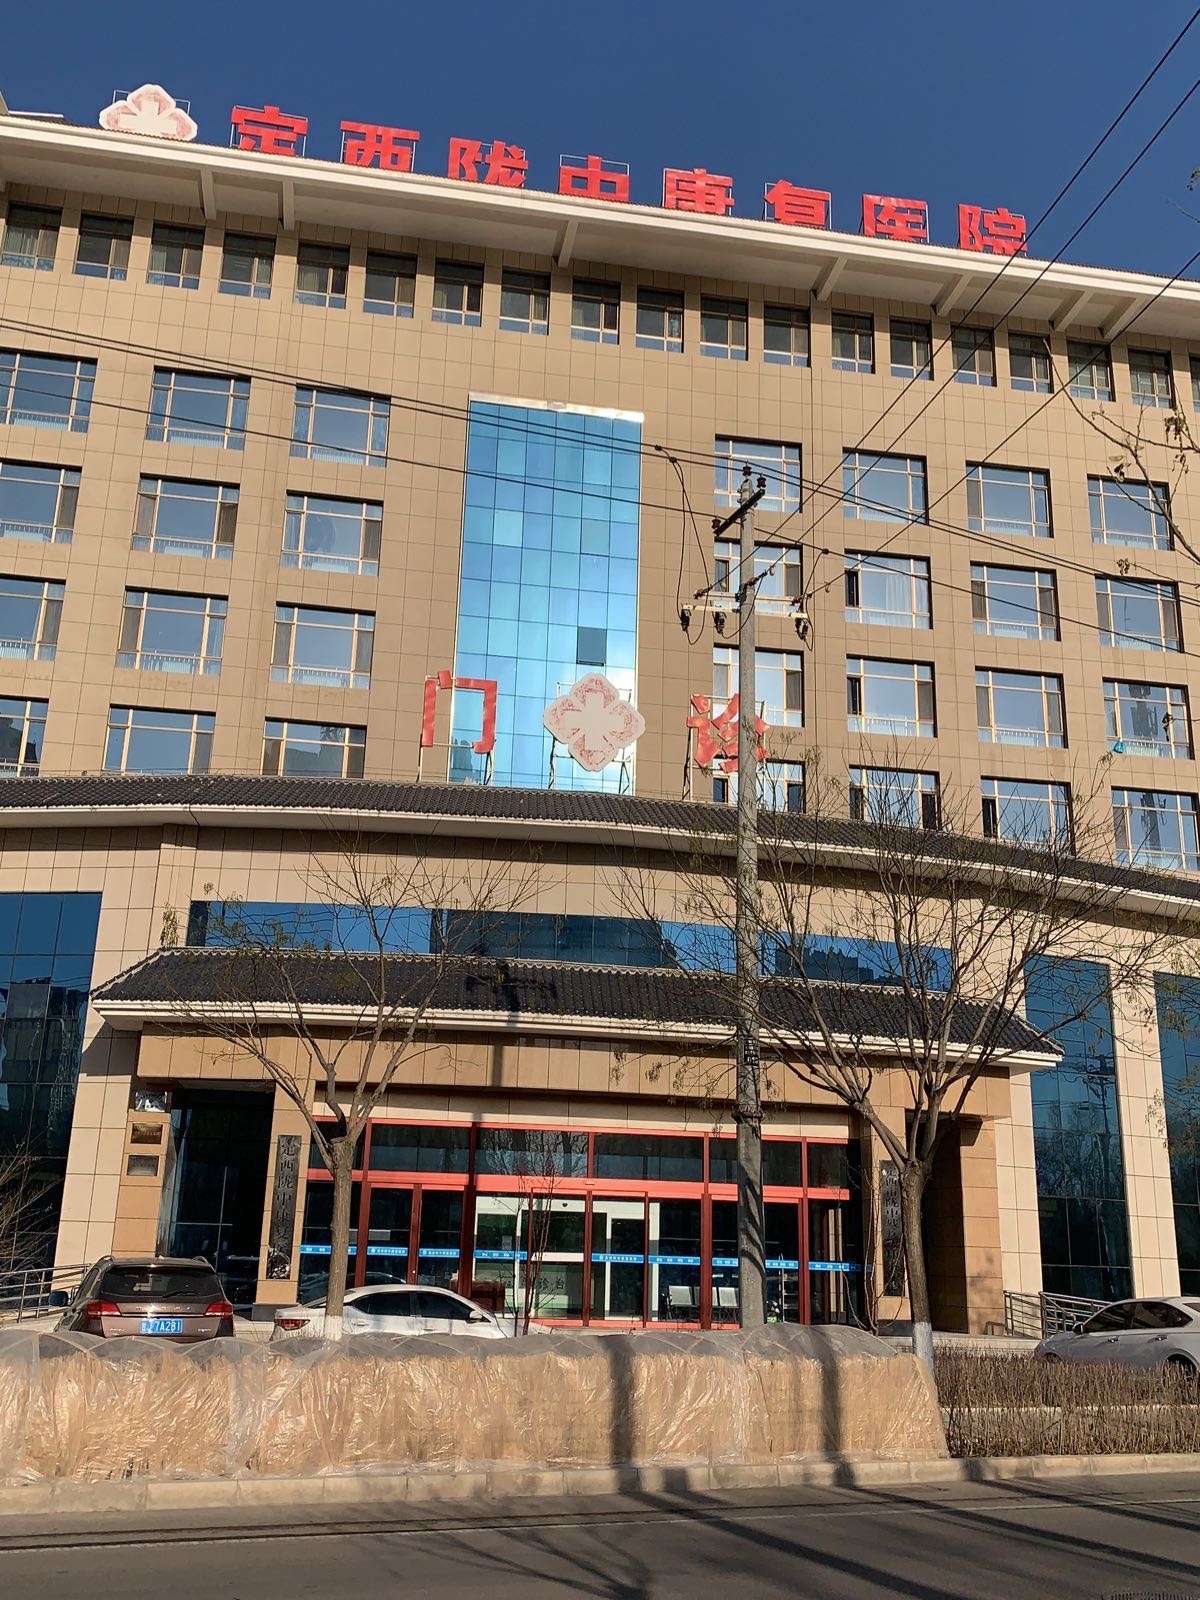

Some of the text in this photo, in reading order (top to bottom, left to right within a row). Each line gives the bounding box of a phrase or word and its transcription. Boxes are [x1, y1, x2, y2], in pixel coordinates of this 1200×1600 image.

[230, 104, 1028, 256] 定西陇中康复医院
[271, 1139, 296, 1278] 定西陇中康复医
